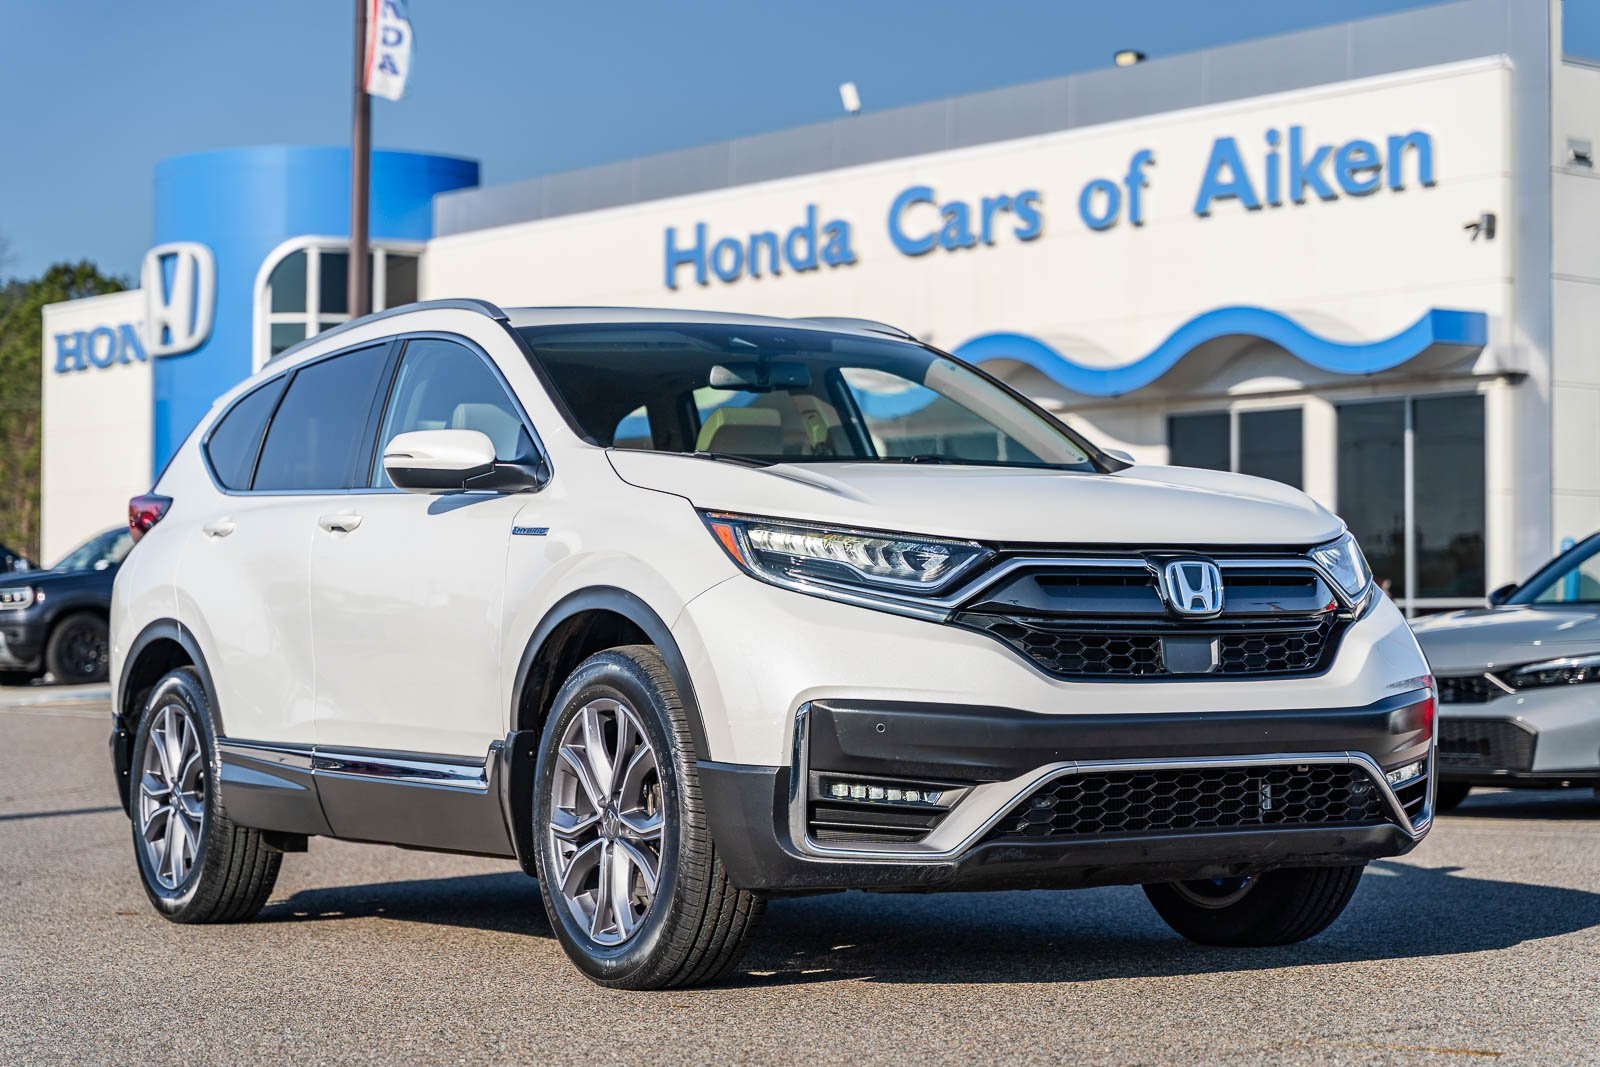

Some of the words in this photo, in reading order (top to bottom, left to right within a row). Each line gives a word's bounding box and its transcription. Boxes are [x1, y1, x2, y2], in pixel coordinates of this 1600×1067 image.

[664, 204, 856, 290] Honda
[887, 185, 1042, 256] Cars
[1078, 149, 1155, 231] of
[1193, 125, 1436, 218] Aiken
